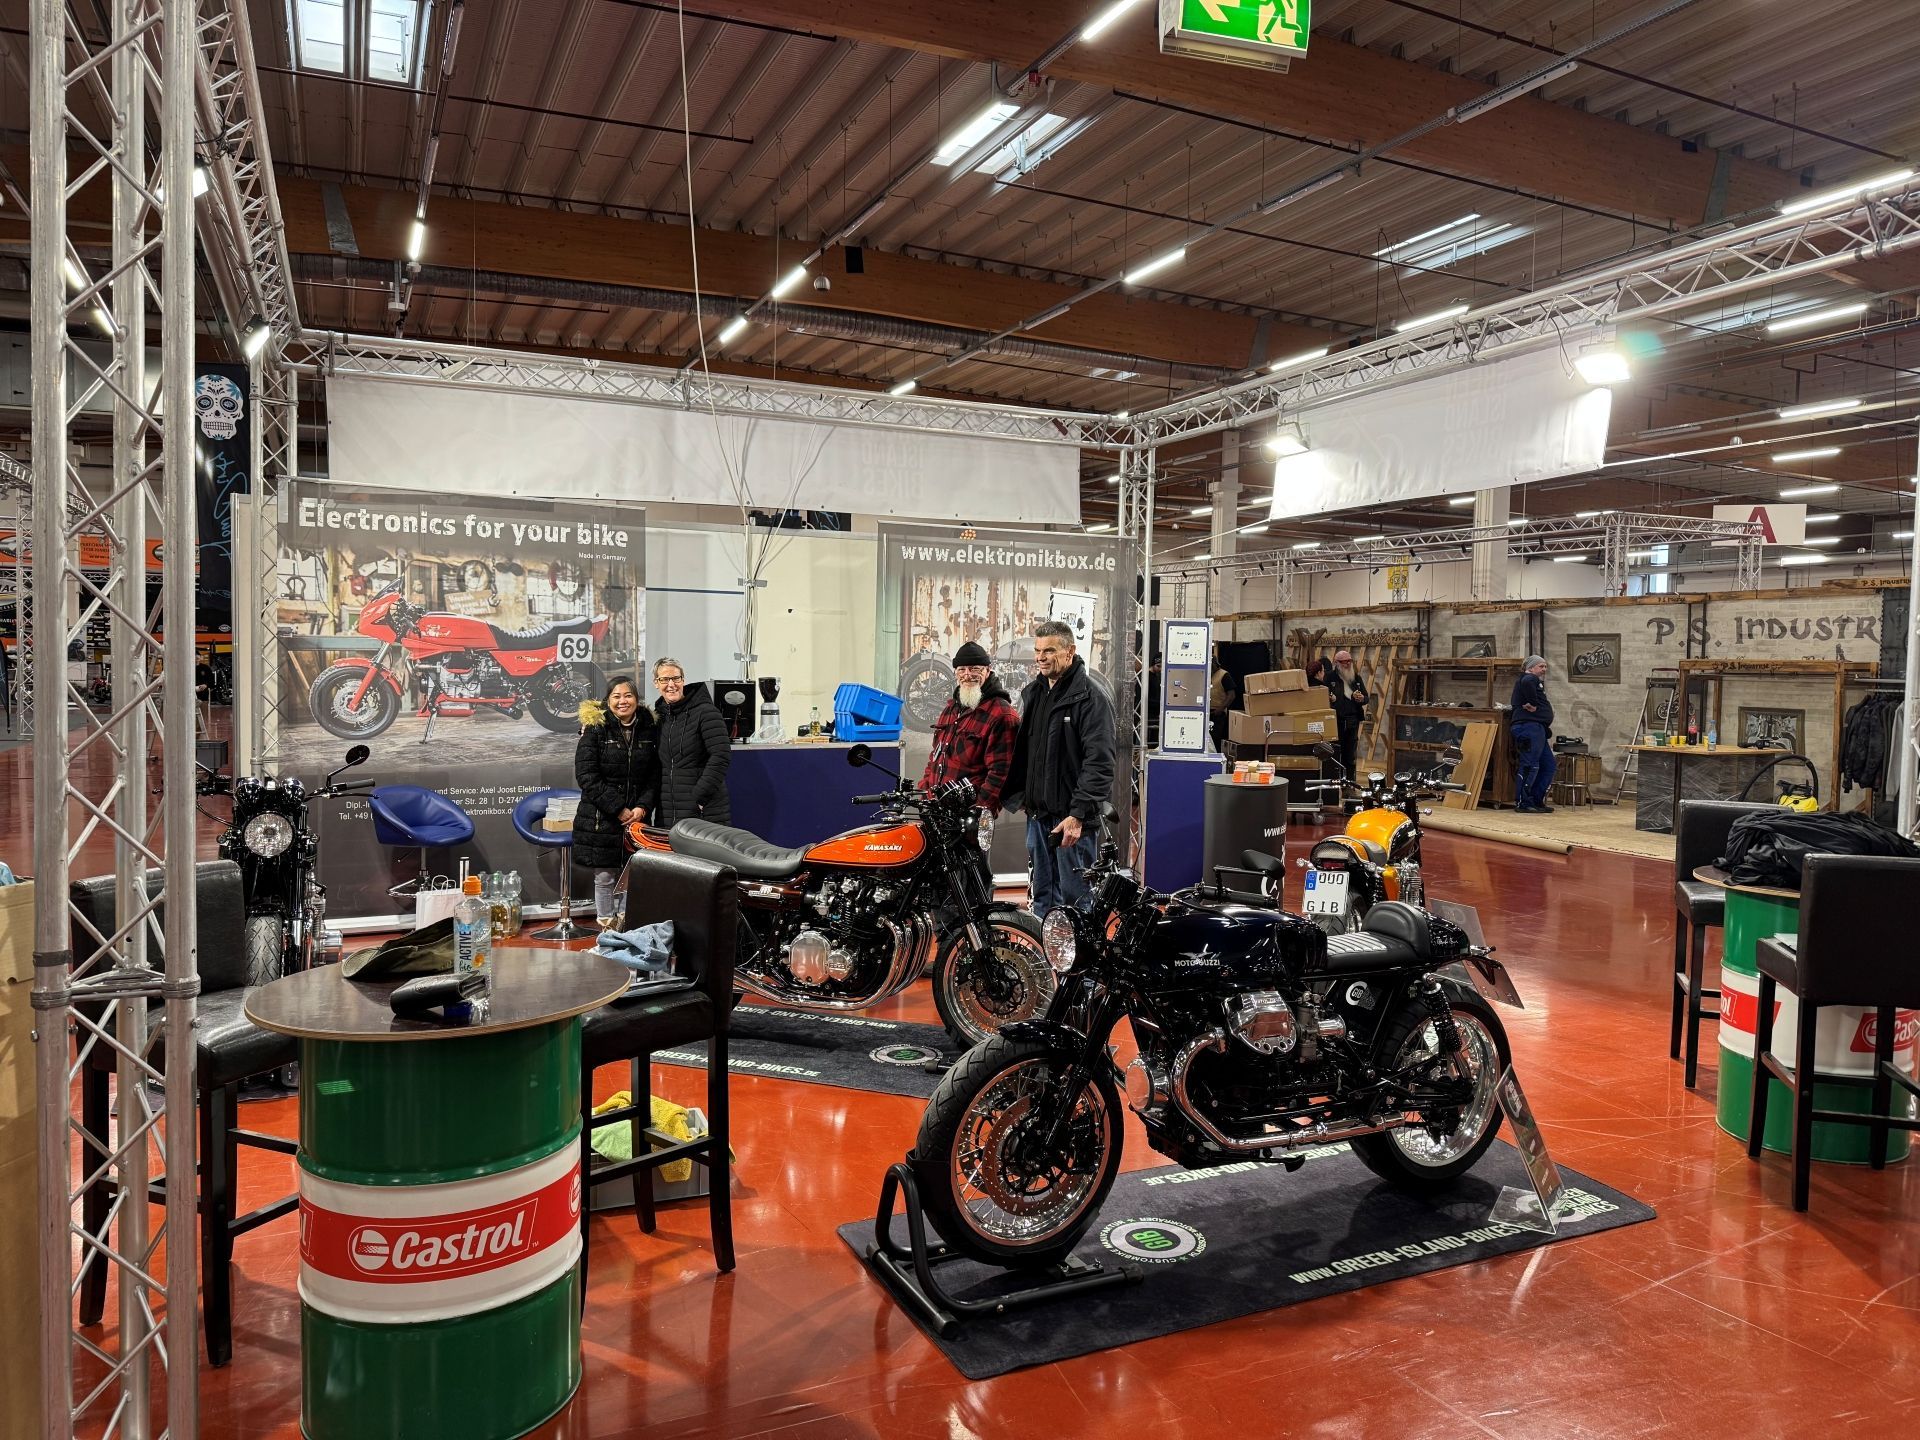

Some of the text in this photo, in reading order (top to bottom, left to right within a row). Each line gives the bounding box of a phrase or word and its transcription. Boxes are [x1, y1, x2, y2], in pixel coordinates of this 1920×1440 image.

[298, 500, 629, 548] Electronics for your bike
[1738, 506, 1778, 544] A
[578, 551, 594, 560] Made
[602, 553, 627, 563] Germany
[901, 544, 1116, 572] www.elektronikbox.de
[1646, 616, 1722, 648] P.S.
[560, 637, 590, 659] 69
[450, 787, 479, 795] Service:
[480, 786, 496, 794] Axel
[497, 786, 516, 794] Joost
[518, 785, 551, 793] Elektronik
[465, 797, 477, 805] Str.
[479, 797, 488, 805] 28
[338, 812, 352, 820] Tel.
[354, 811, 369, 820] +49
[864, 844, 903, 852] KAWASAKI
[459, 924, 473, 961] ACTIVE
[1572, 1200, 1620, 1217] BIKES
[391, 1210, 526, 1269] Castrol
[1131, 1230, 1174, 1250] GIB
